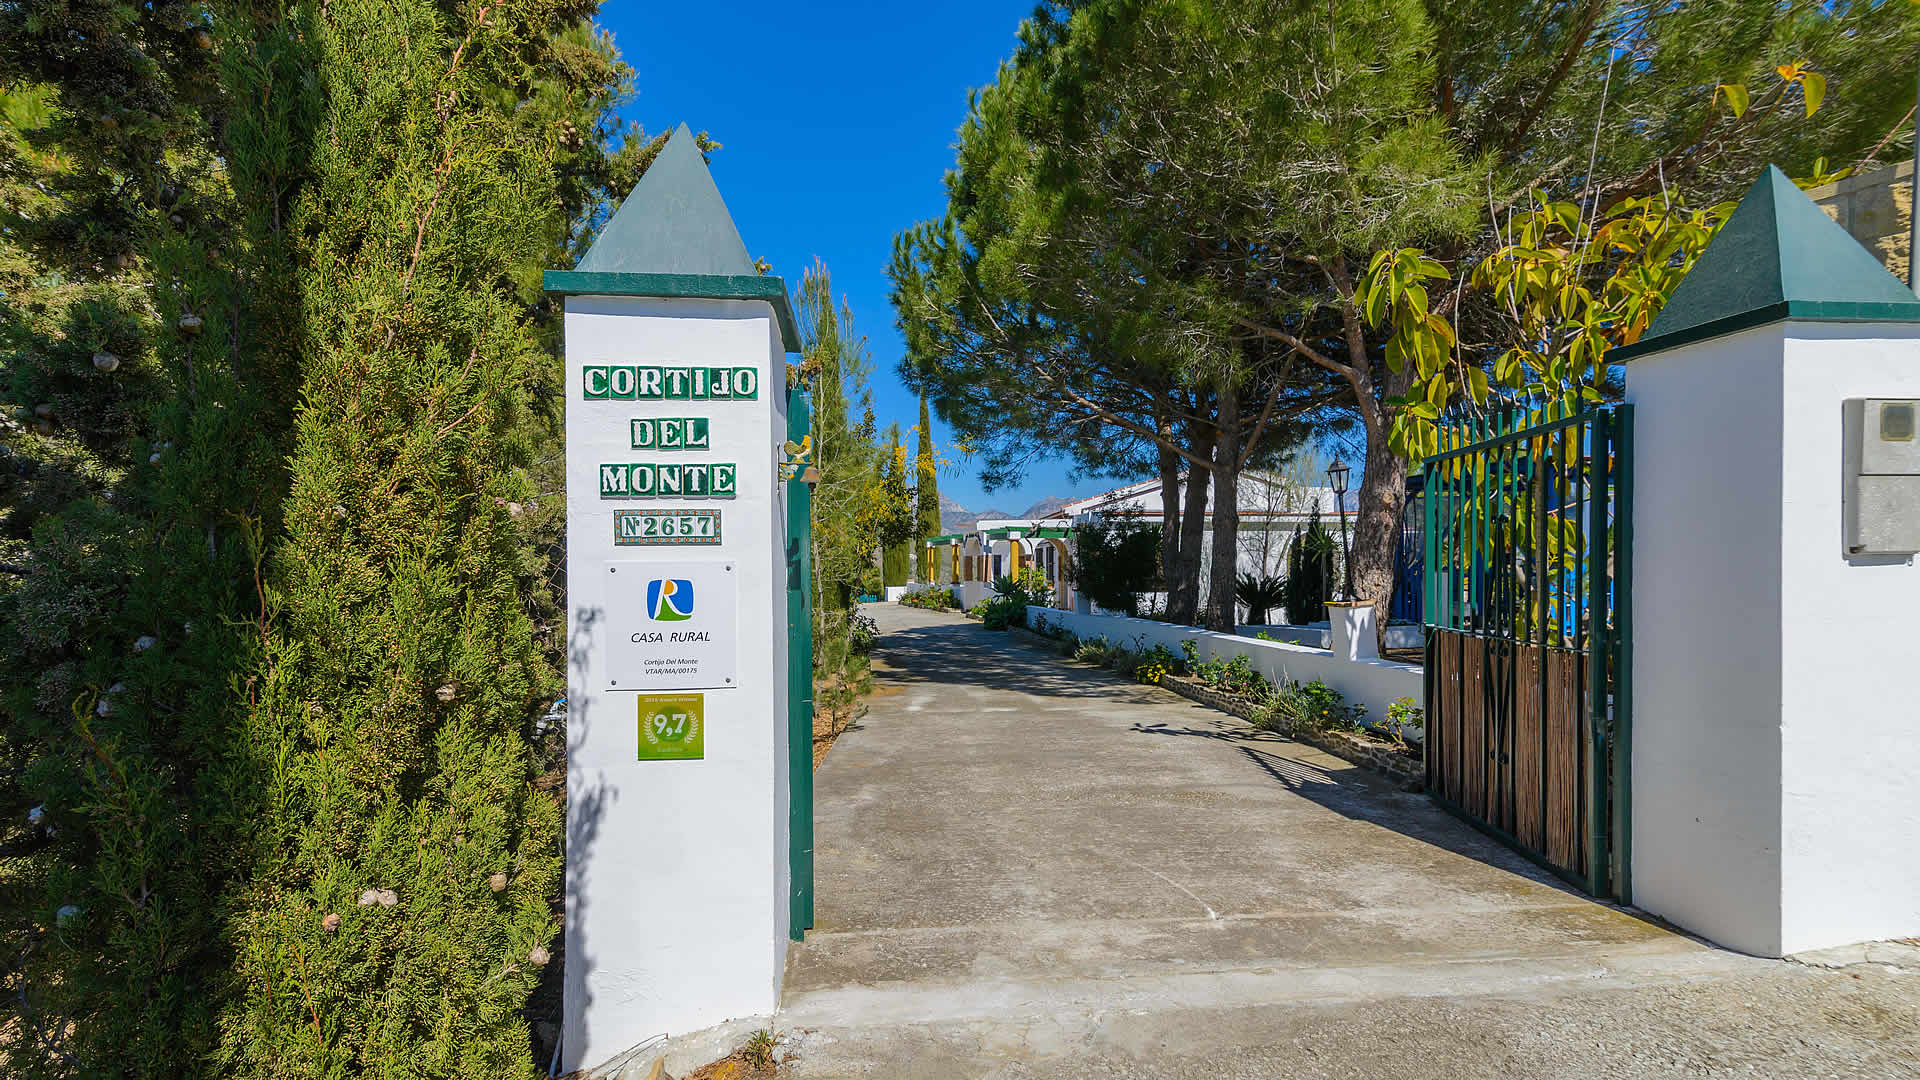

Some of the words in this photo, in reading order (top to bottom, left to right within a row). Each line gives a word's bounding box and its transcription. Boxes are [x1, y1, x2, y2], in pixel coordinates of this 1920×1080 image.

[583, 368, 757, 396] CORTIJO
[632, 419, 707, 447] DEL
[601, 465, 735, 493] MONTE
[631, 632, 663, 643] CASA
[670, 631, 711, 643] RURAL
[643, 658, 665, 667] Cortijo
[653, 713, 687, 737] 9,7
